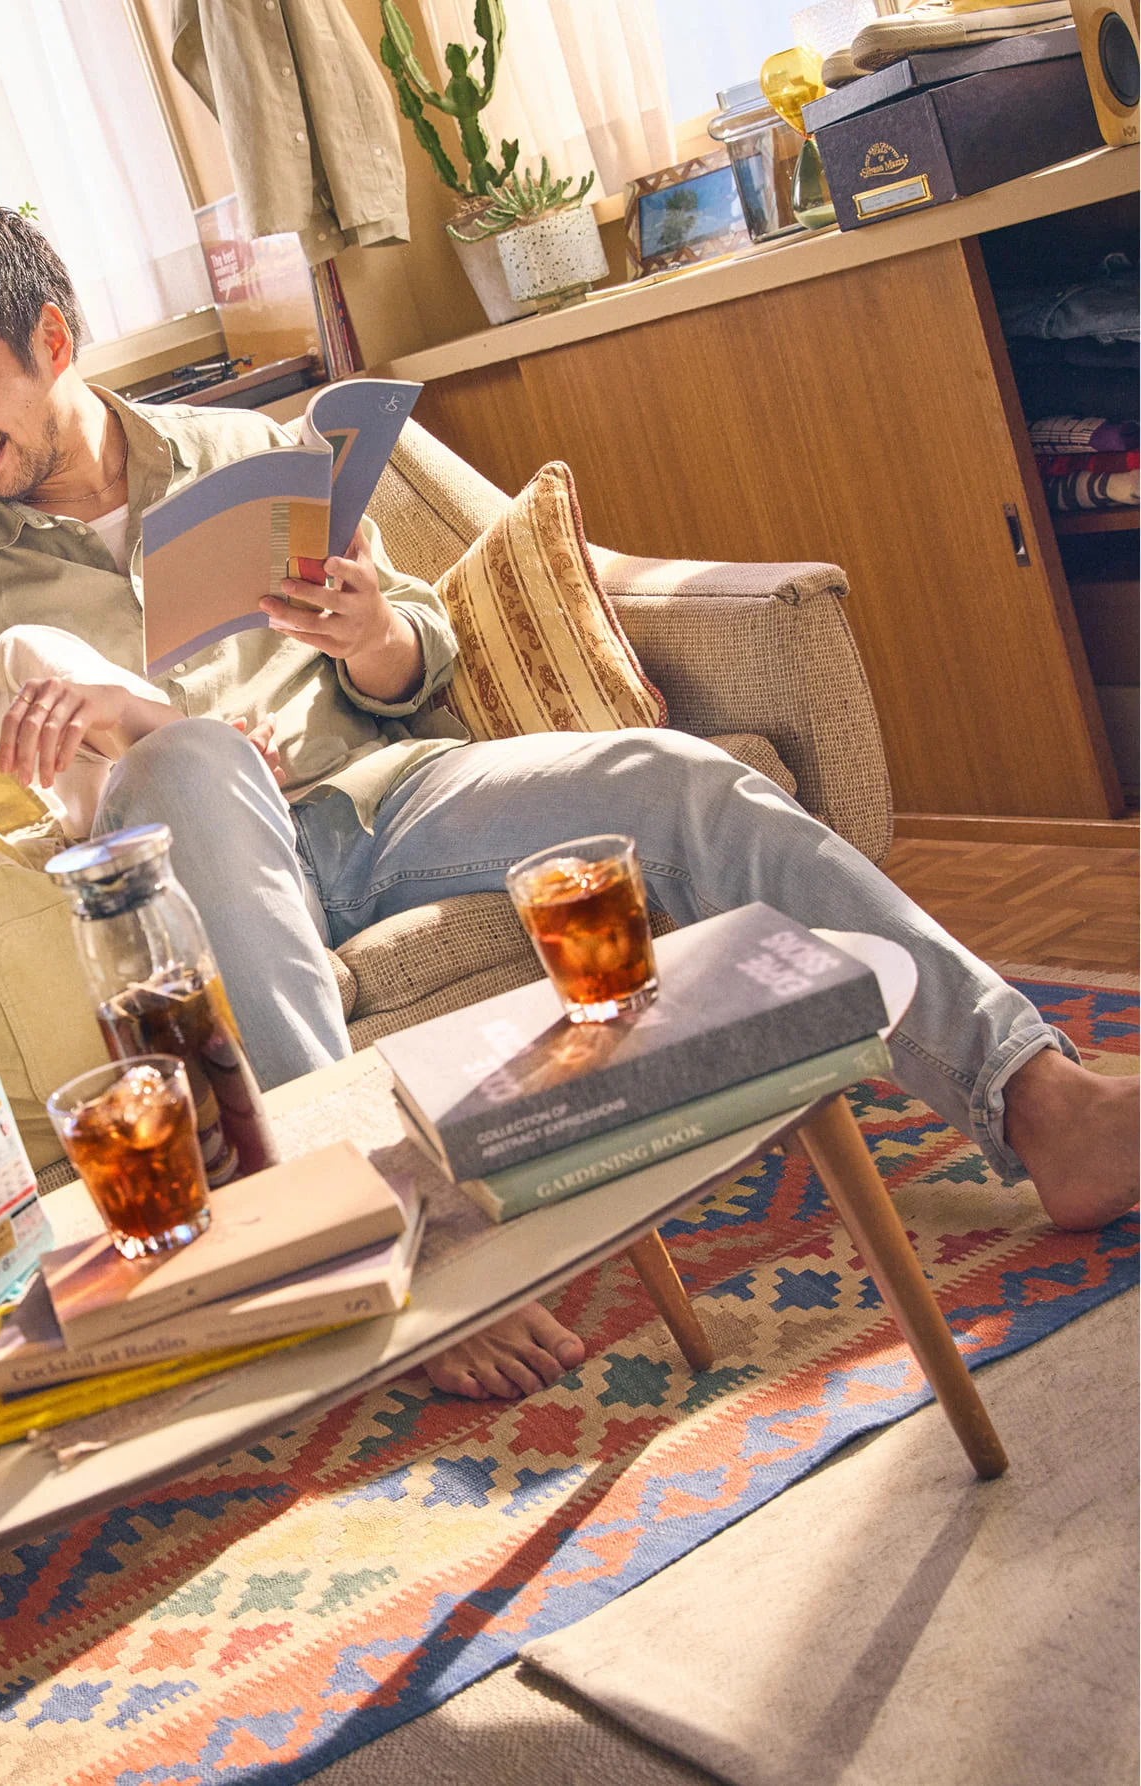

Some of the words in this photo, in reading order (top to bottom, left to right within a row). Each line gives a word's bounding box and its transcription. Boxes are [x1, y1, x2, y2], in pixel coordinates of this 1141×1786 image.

[476, 1110, 551, 1145] COLLECTION
[551, 1103, 568, 1119] OF
[482, 1127, 542, 1158] ABSTRACT
[543, 1098, 627, 1137] EXPRESSIONS
[536, 1144, 648, 1198] GARDENING
[650, 1122, 705, 1154] BOOK
[11, 1353, 96, 1381] Cocktail
[100, 1349, 119, 1364] at
[124, 1337, 187, 1359] Radio
